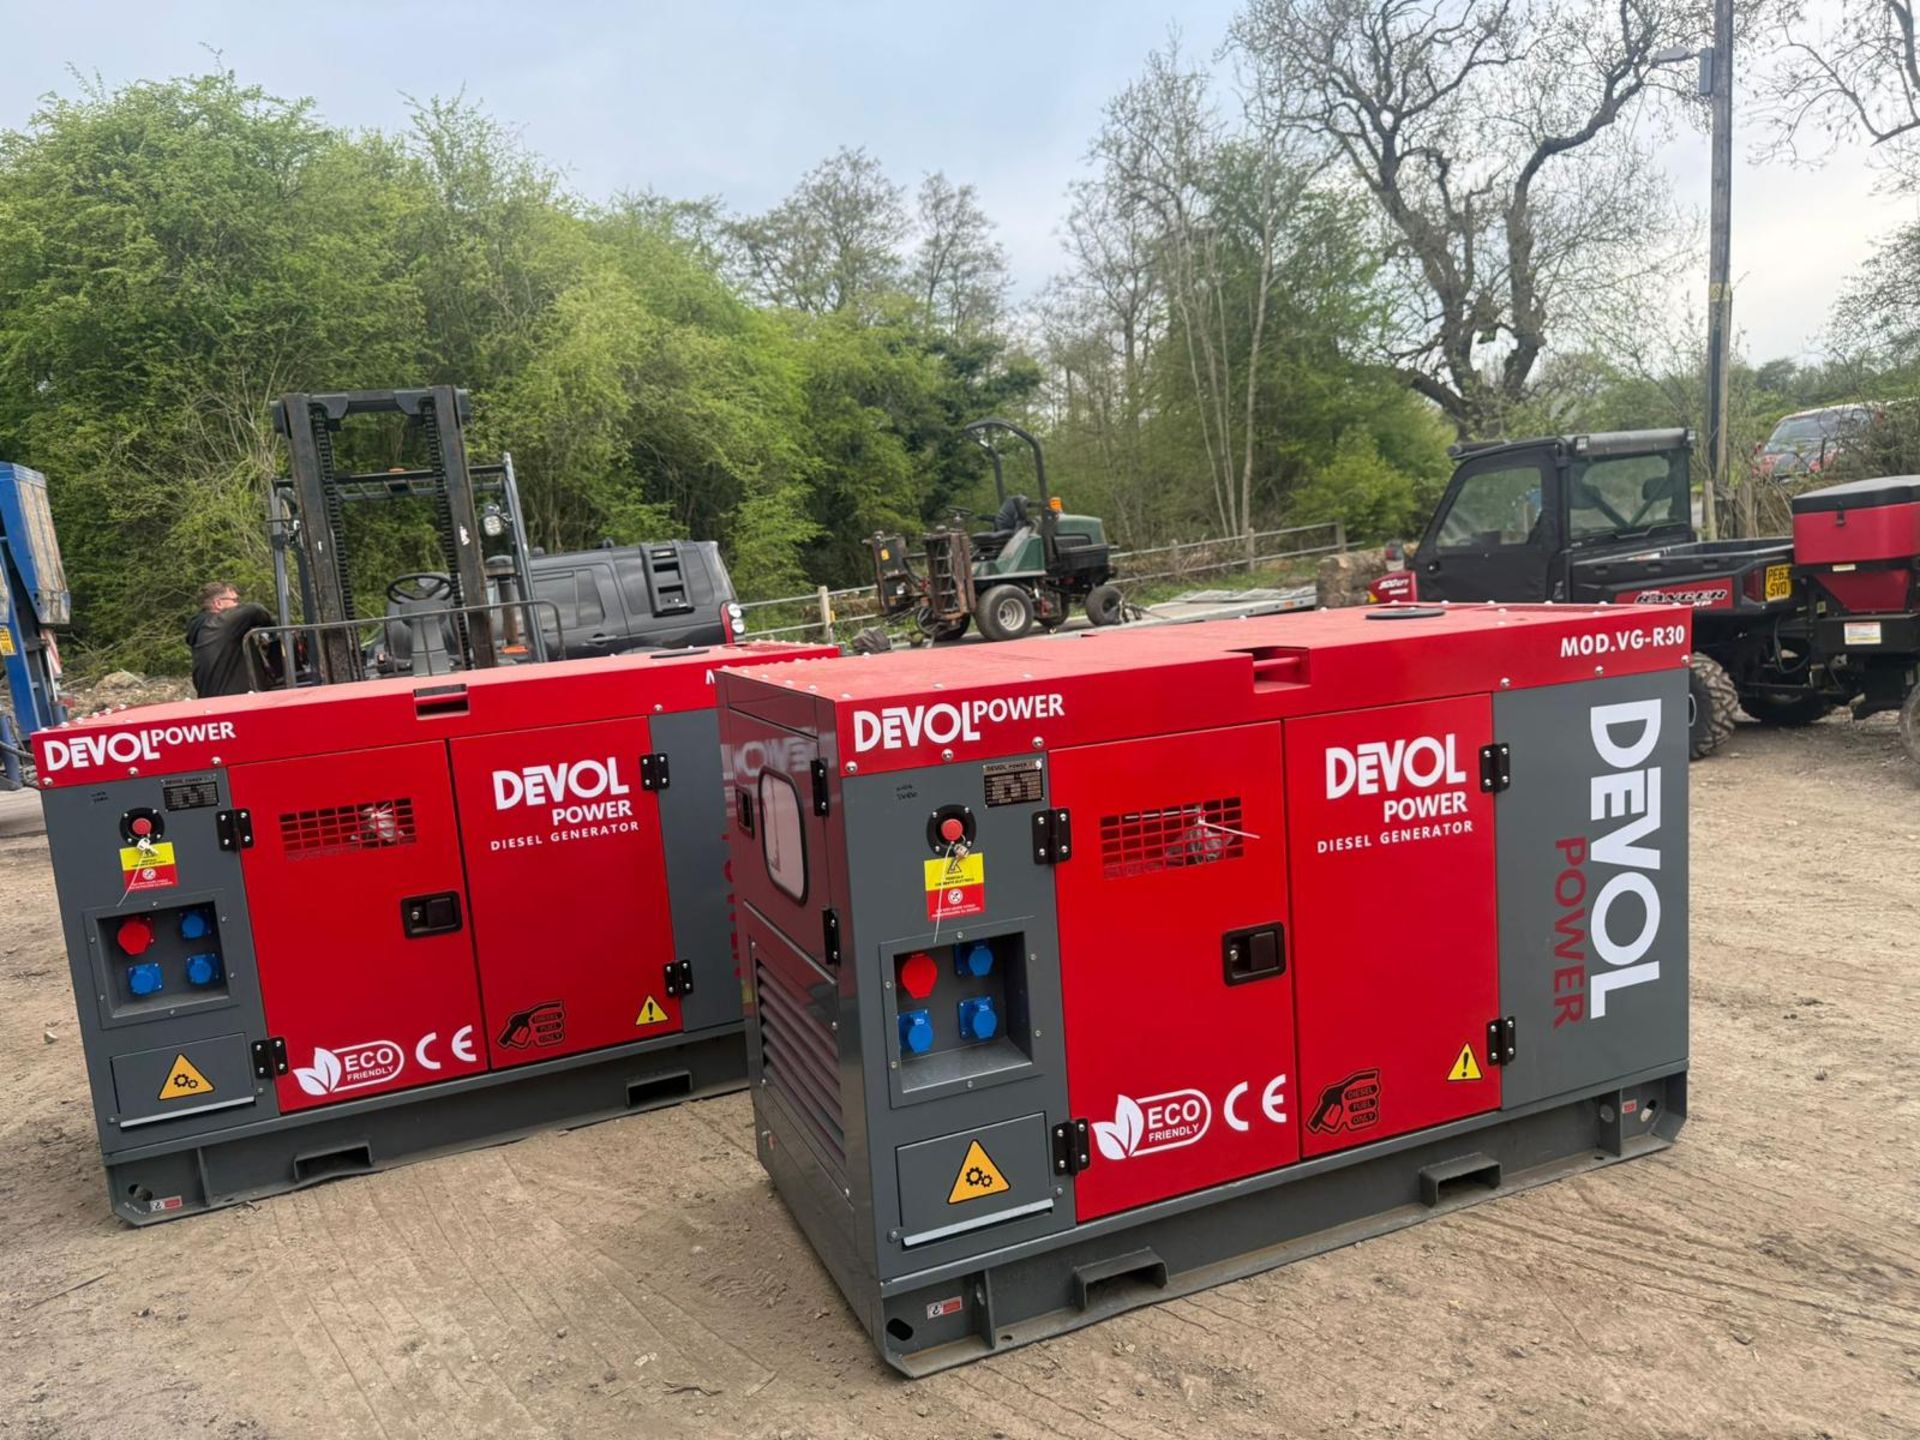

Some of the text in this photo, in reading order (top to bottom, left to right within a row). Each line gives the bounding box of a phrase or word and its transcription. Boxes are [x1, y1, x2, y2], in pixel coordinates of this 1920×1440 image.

[1560, 626, 1686, 658] MOD.VG-R30
[854, 693, 1066, 753] DEVOL POWER
[42, 721, 236, 771] DEVOL POWER
[1325, 733, 1467, 800] DEVOL
[492, 757, 630, 811] DEVOL
[551, 799, 633, 827] POWER
[1382, 791, 1469, 824] POWER
[490, 822, 639, 851] DIESEL GENERATOR
[1317, 821, 1473, 853] DIESEL GENERATOR
[1590, 697, 1663, 1020] DEVOL
[1553, 836, 1586, 1029] POWER
[344, 1046, 393, 1073] ECO
[346, 1064, 395, 1083] FRIENDLY
[1147, 1099, 1202, 1130] ECO
[1148, 1123, 1200, 1143] FRIENDLY
